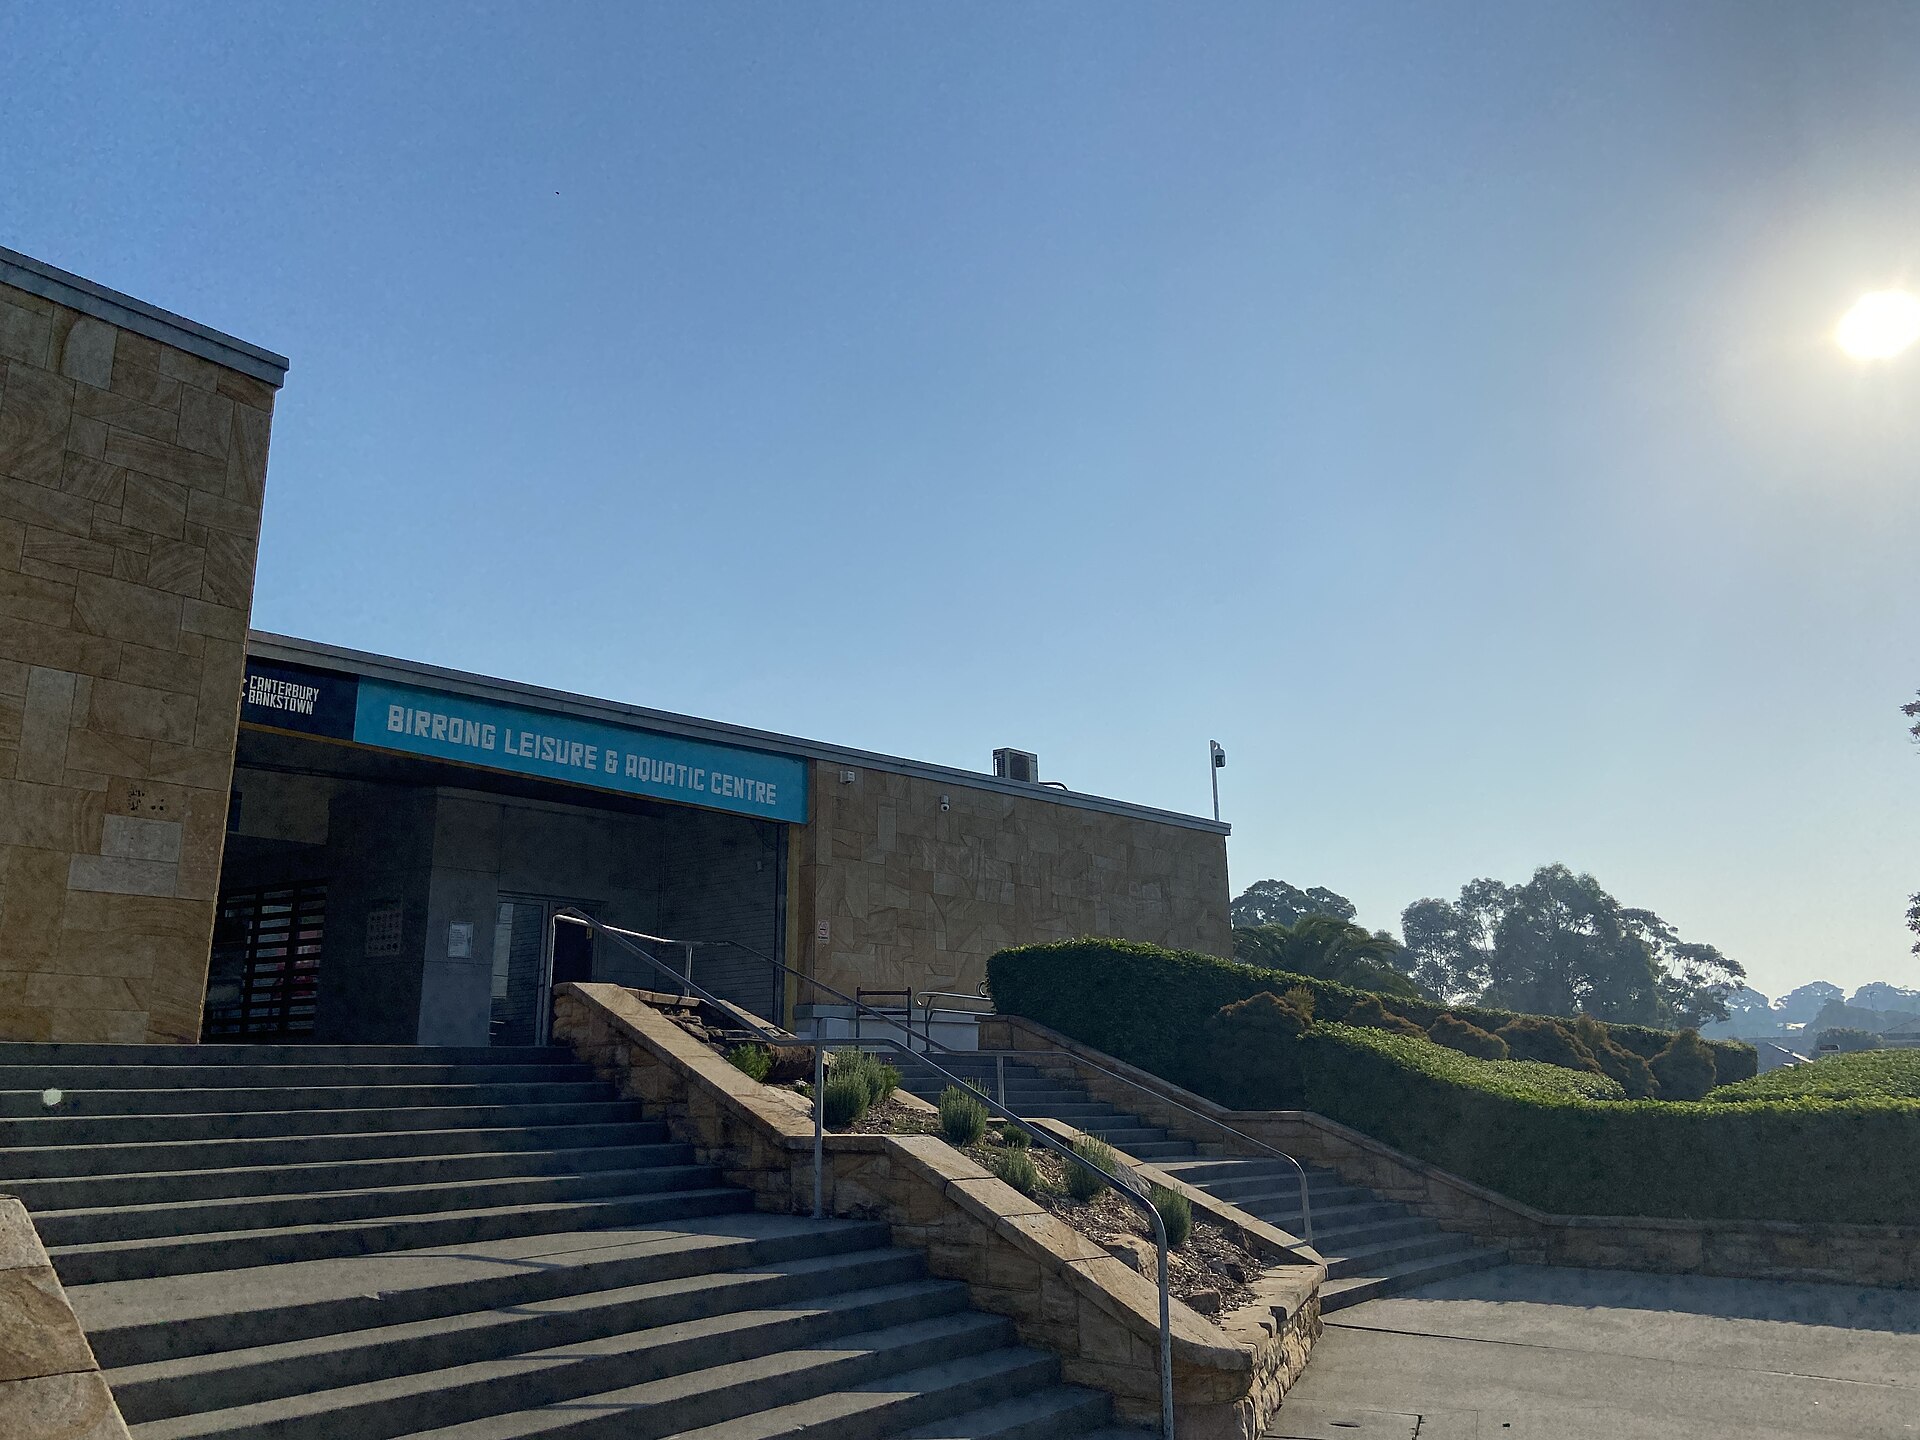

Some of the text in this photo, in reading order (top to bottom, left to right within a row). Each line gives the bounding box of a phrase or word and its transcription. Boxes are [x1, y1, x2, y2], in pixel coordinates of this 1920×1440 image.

[248, 689, 314, 715] BANKSTOWN
[249, 675, 320, 702] CANTERBURY
[388, 704, 776, 805] BIRRONG LEISURE & AQUATIC CENTRE
